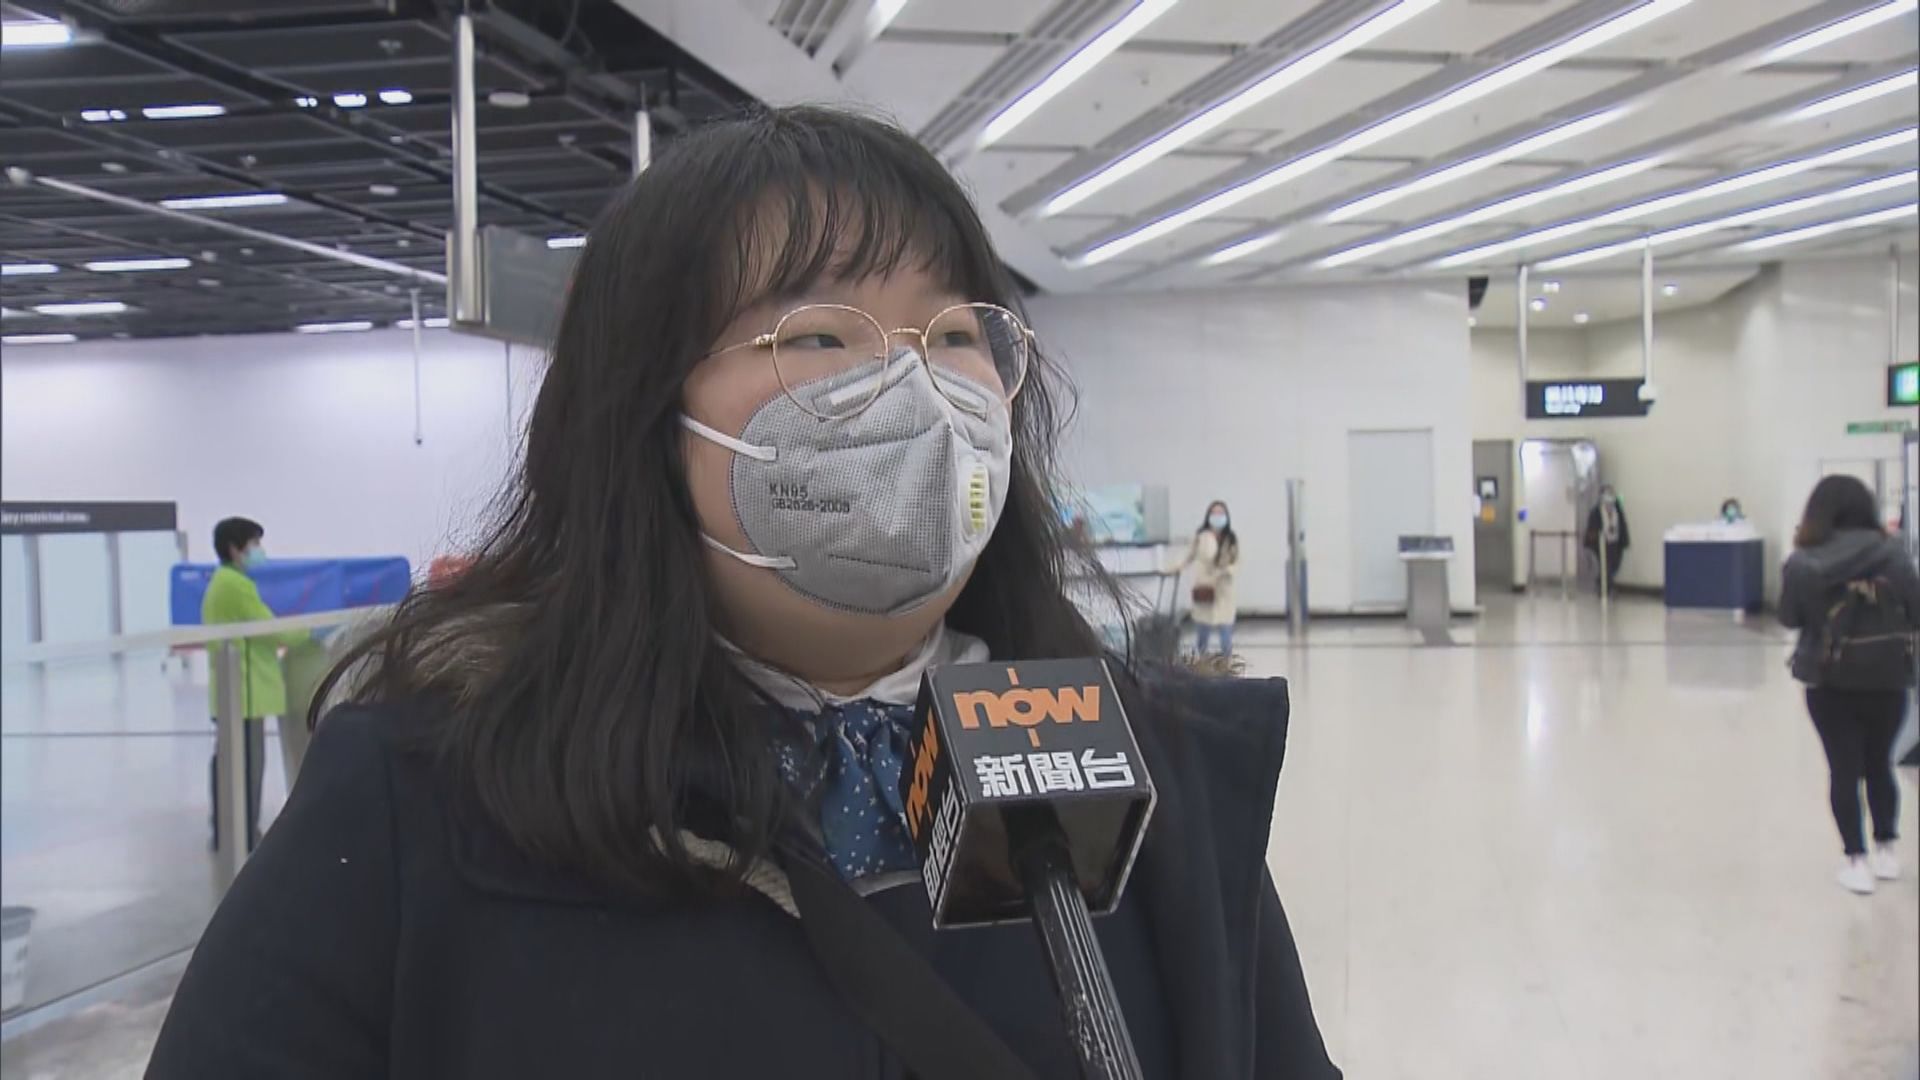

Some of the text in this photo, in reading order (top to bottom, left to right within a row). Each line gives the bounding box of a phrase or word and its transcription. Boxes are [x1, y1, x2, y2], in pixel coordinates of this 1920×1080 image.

[769, 483, 809, 500] KN95
[953, 686, 1100, 729] now
[973, 748, 1136, 797] 新聞台
